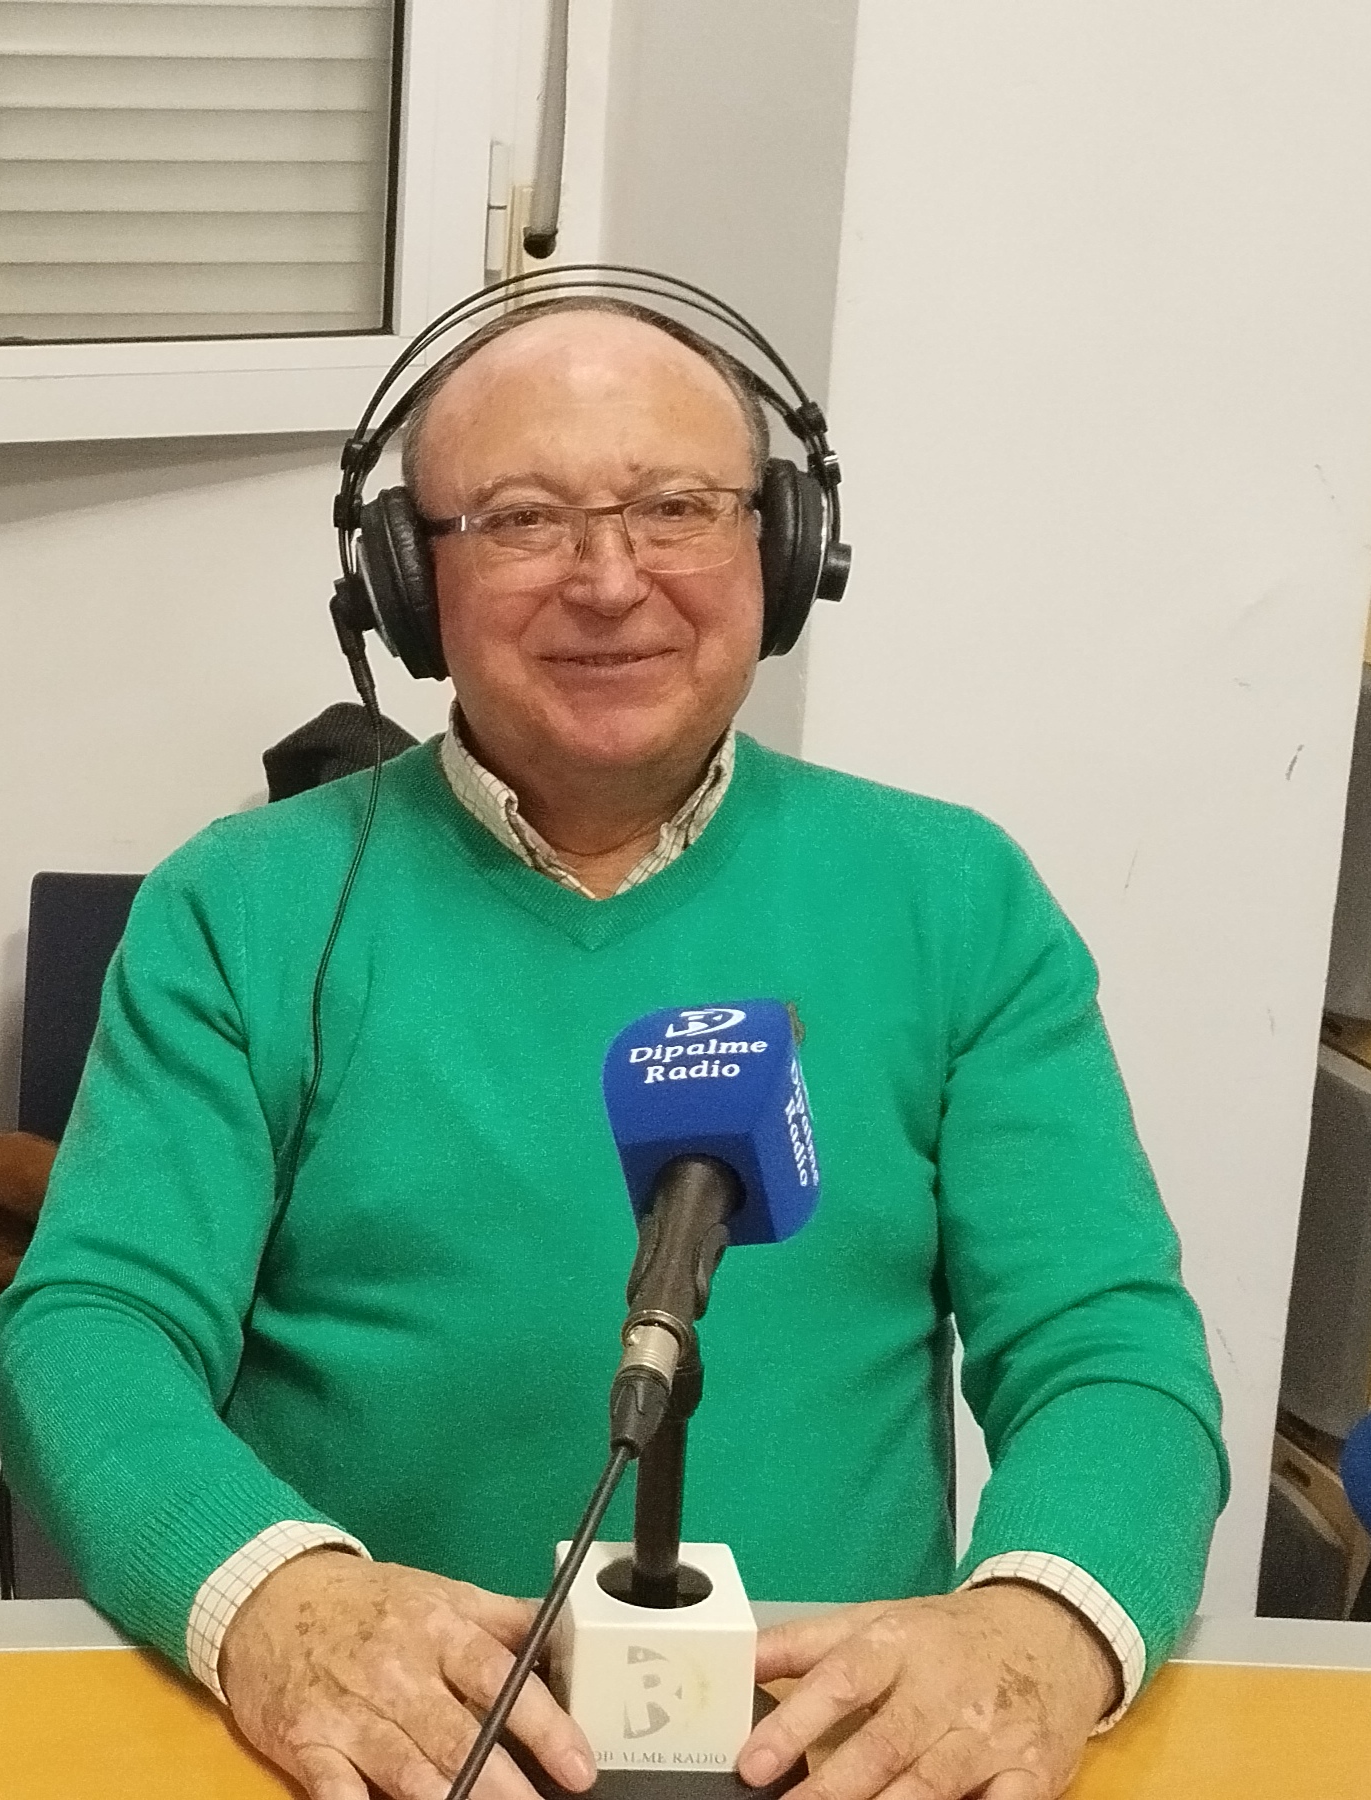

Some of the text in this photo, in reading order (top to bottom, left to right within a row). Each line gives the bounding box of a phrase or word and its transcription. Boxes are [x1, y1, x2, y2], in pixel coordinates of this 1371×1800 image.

[629, 1039, 768, 1063] Dipalme
[644, 1060, 740, 1083] Radio
[785, 1096, 808, 1186] Radio
[672, 1752, 727, 1764] RADIO
